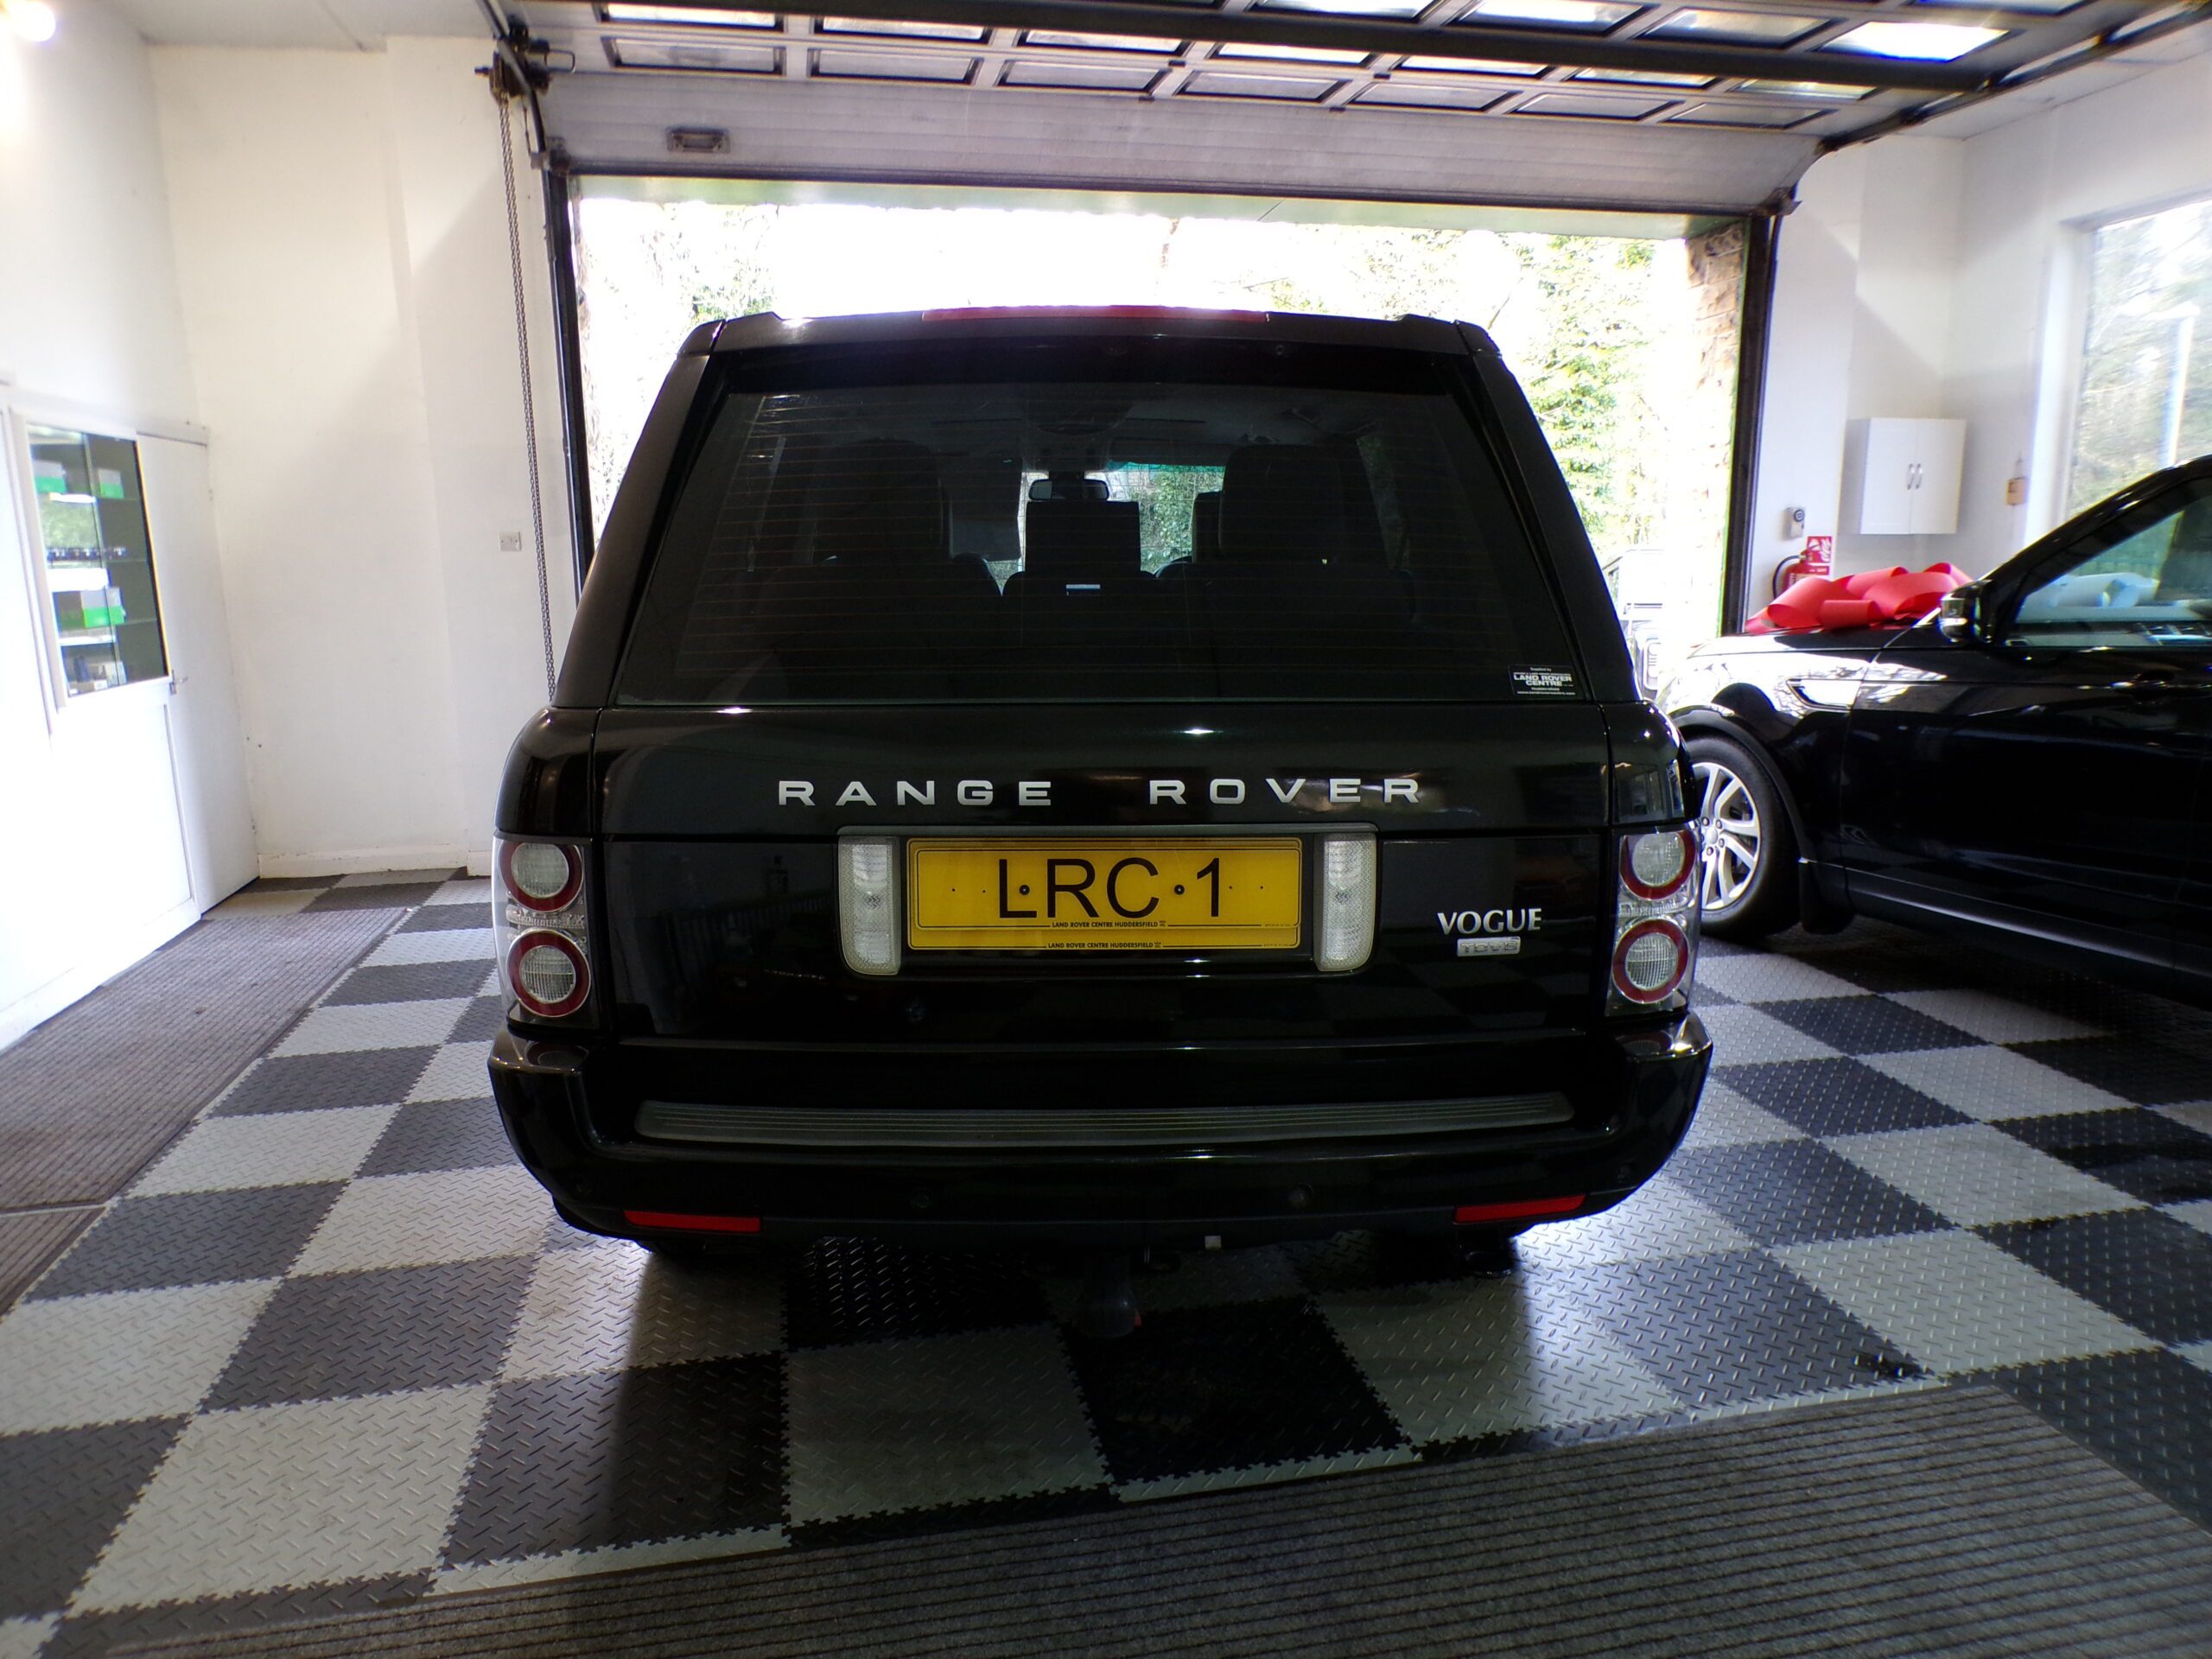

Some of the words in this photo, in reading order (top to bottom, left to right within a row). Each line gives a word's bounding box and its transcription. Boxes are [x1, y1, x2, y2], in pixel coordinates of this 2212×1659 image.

[779, 780, 1052, 806] RANGE
[1149, 779, 1420, 804] ROVER
[999, 857, 1160, 918] LRC
[1196, 857, 1220, 918] 1
[1437, 908, 1541, 935] VOGUE
